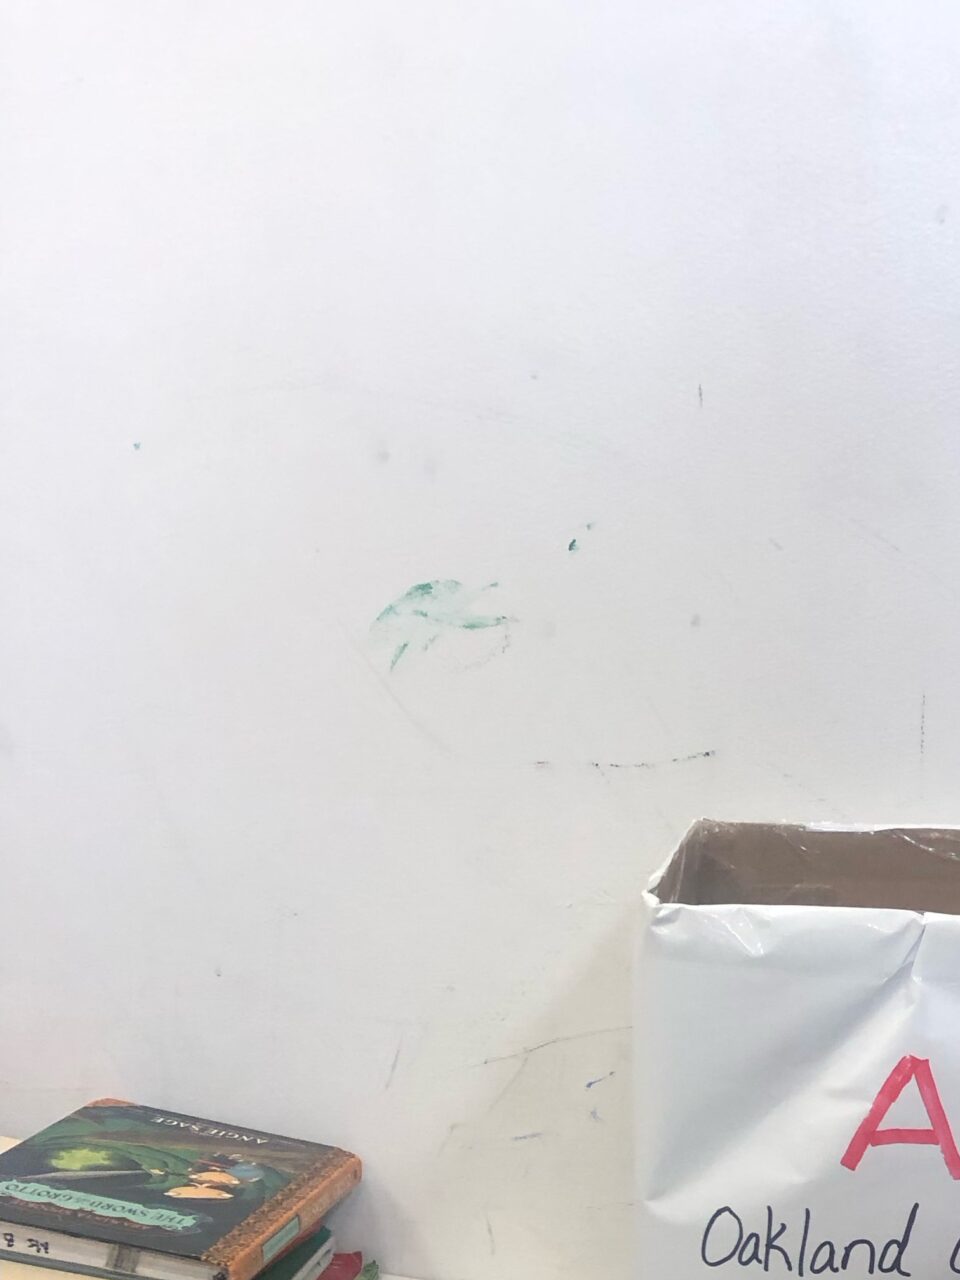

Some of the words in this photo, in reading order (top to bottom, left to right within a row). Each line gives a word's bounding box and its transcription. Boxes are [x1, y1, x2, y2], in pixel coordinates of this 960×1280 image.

[150, 1115, 201, 1132] SAGE
[205, 1127, 269, 1145] ANGIE
[700, 1202, 918, 1277] Oakland
